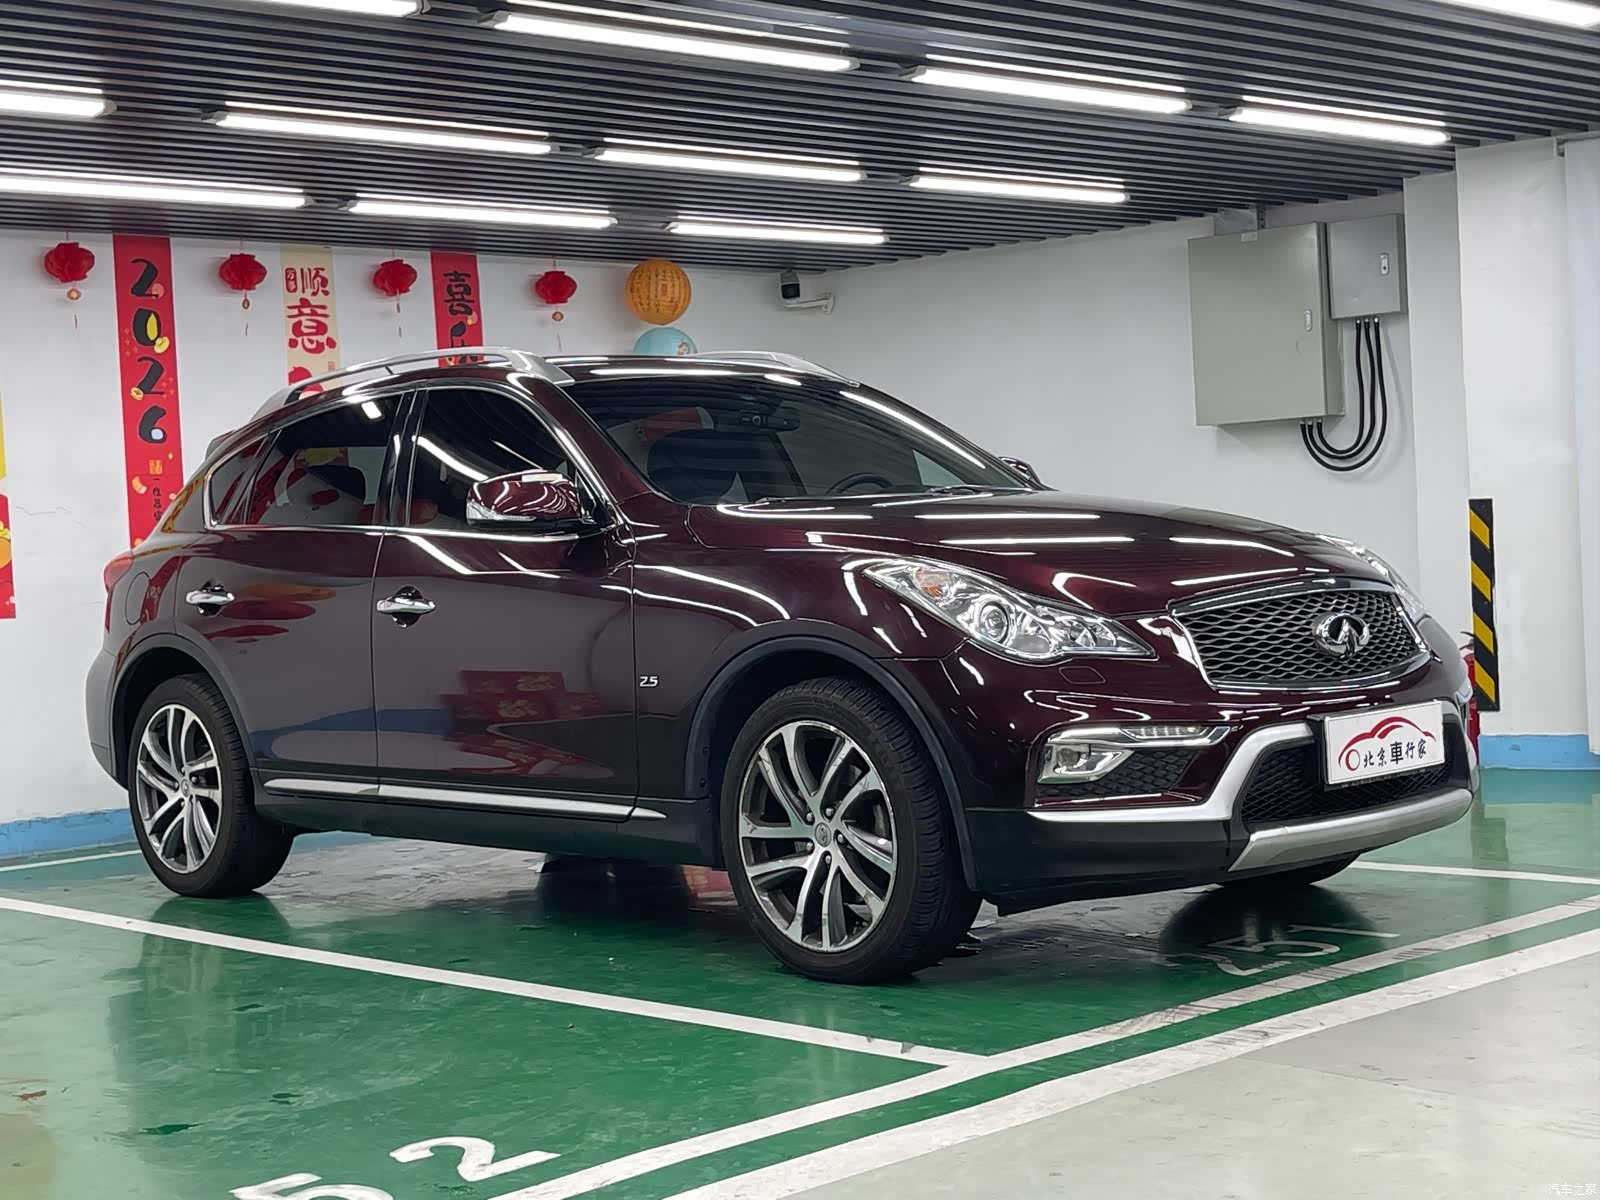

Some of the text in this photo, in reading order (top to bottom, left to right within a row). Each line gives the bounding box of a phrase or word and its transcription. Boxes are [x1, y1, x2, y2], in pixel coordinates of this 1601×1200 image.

[130, 258, 168, 445] 2026
[287, 267, 337, 354] 顺意
[1363, 738, 1427, 768] 北京車行家
